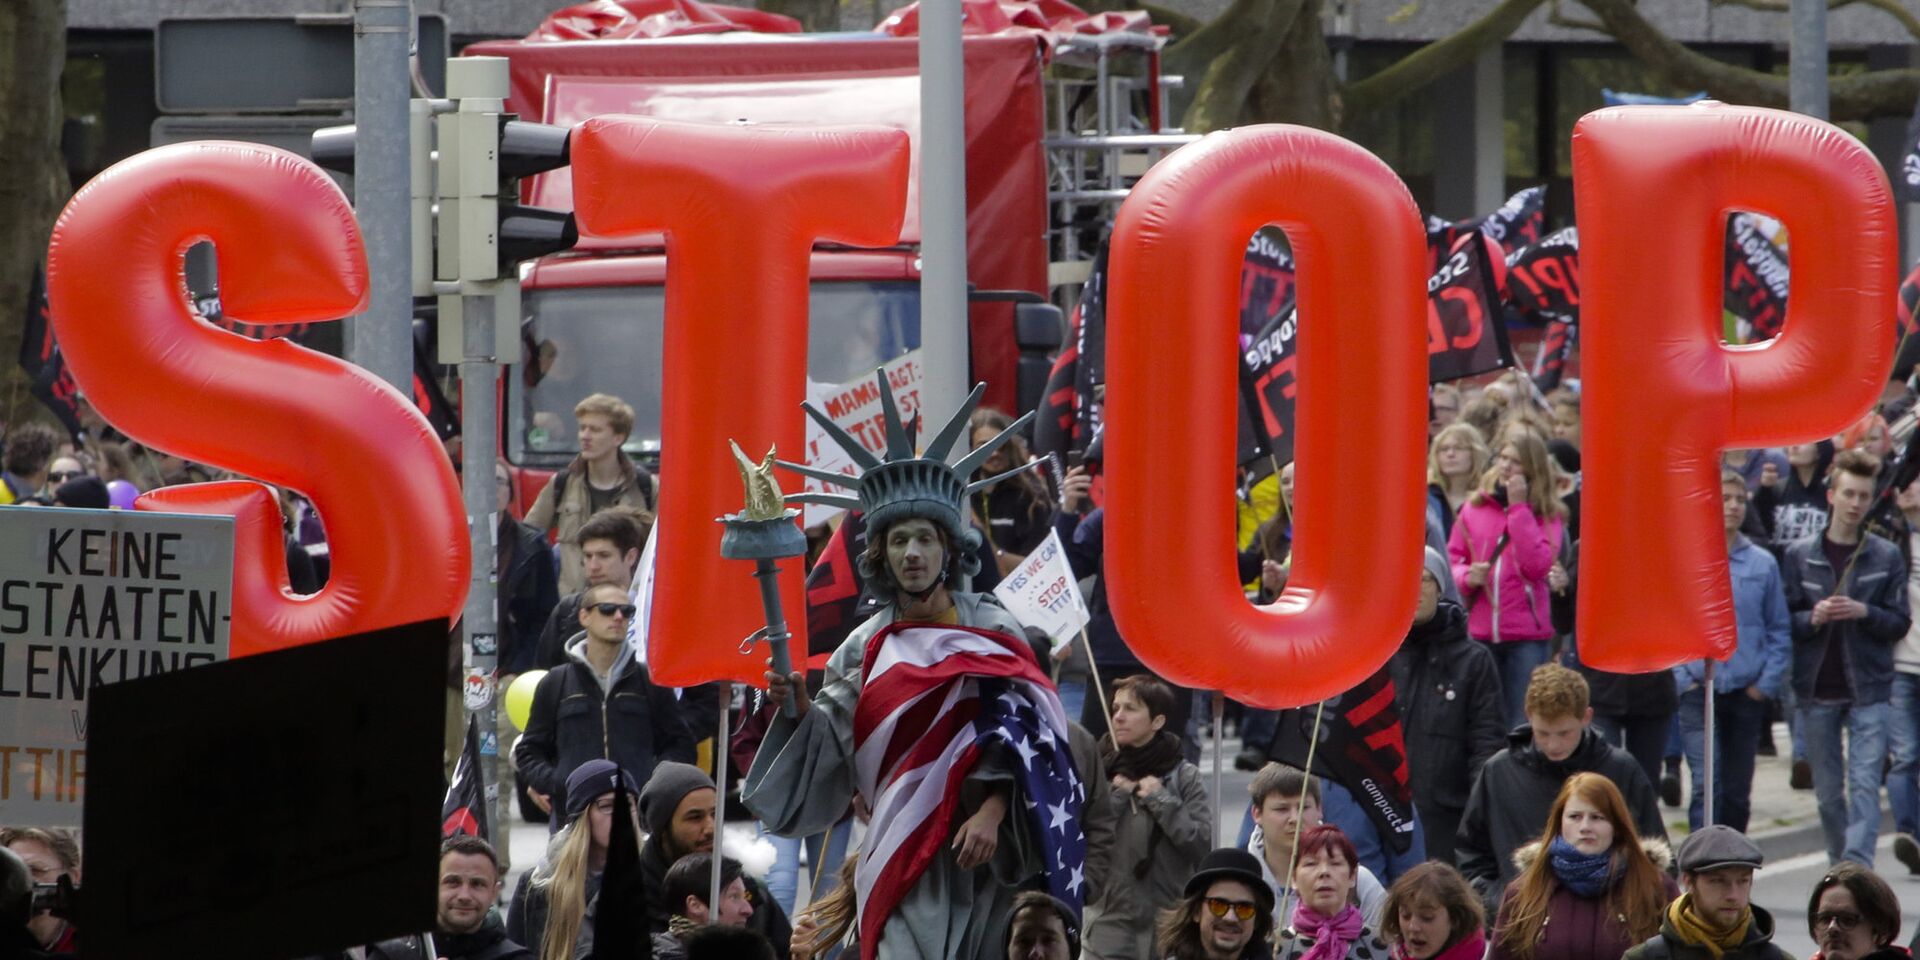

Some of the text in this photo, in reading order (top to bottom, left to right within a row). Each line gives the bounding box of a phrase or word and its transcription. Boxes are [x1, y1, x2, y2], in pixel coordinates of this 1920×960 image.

[888, 361, 923, 391] AGT:
[47, 528, 182, 581] KEINE
[1006, 572, 1028, 594] YES
[1024, 558, 1044, 577] WE
[0, 580, 231, 645] STAATEN-
[1038, 575, 1067, 608] STOP
[0, 643, 216, 701] LENKU
